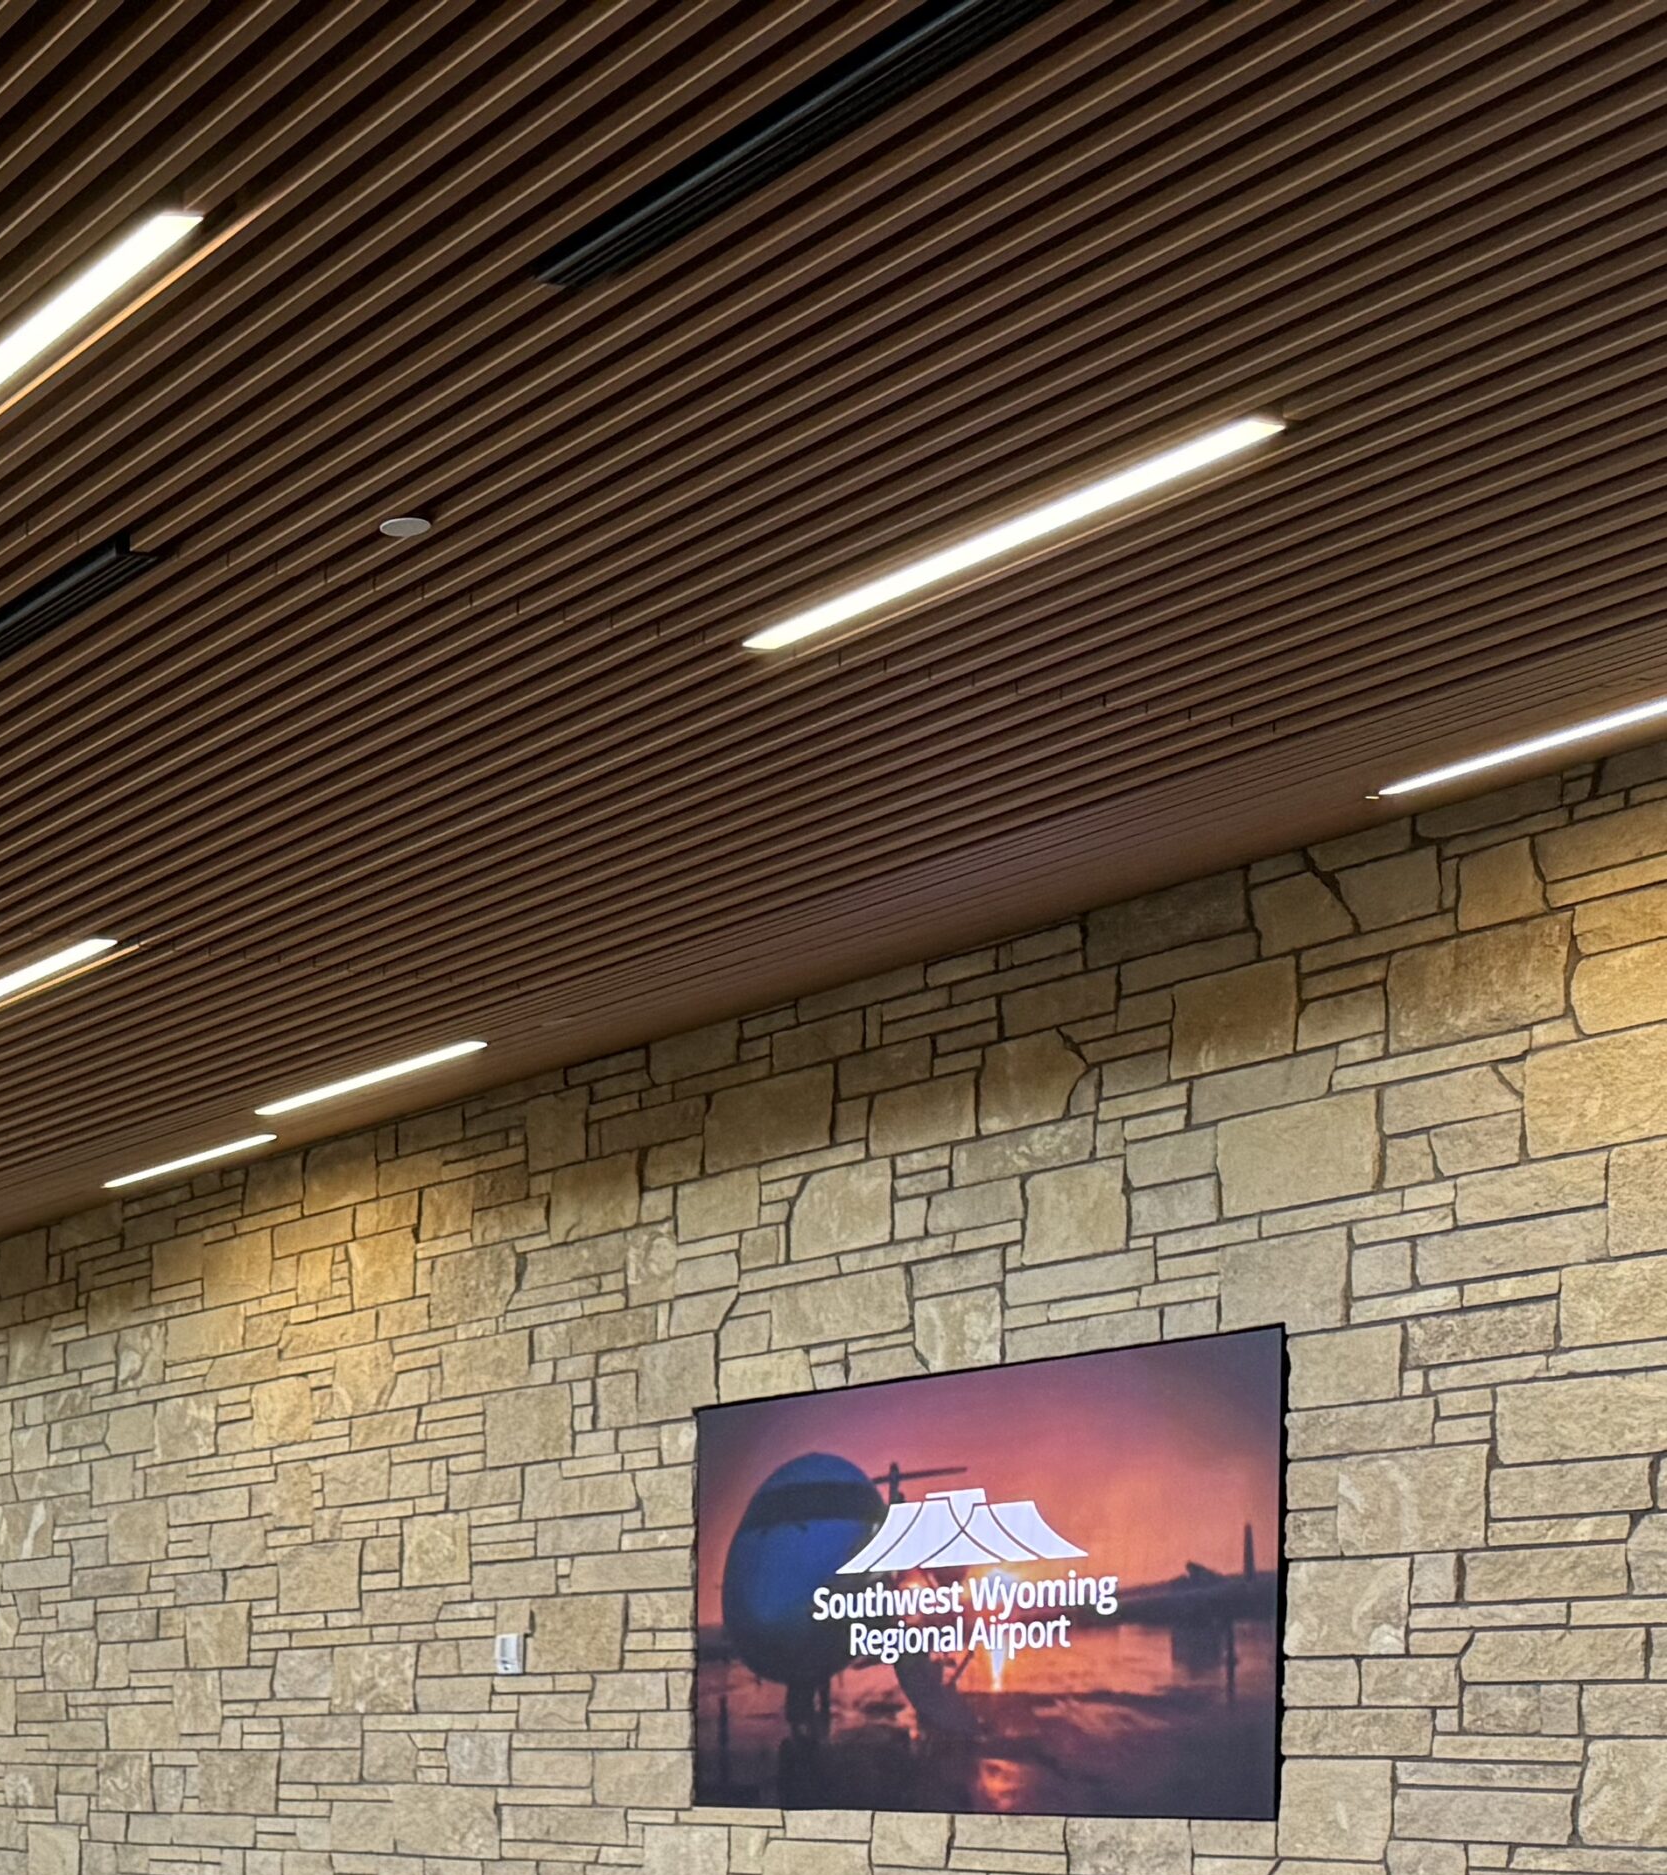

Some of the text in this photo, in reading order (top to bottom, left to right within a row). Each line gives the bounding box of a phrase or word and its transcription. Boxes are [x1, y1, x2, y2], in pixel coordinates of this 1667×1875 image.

[812, 1569, 1118, 1621] Southwest Wyoming
[849, 1615, 1071, 1664] Regional Airport
